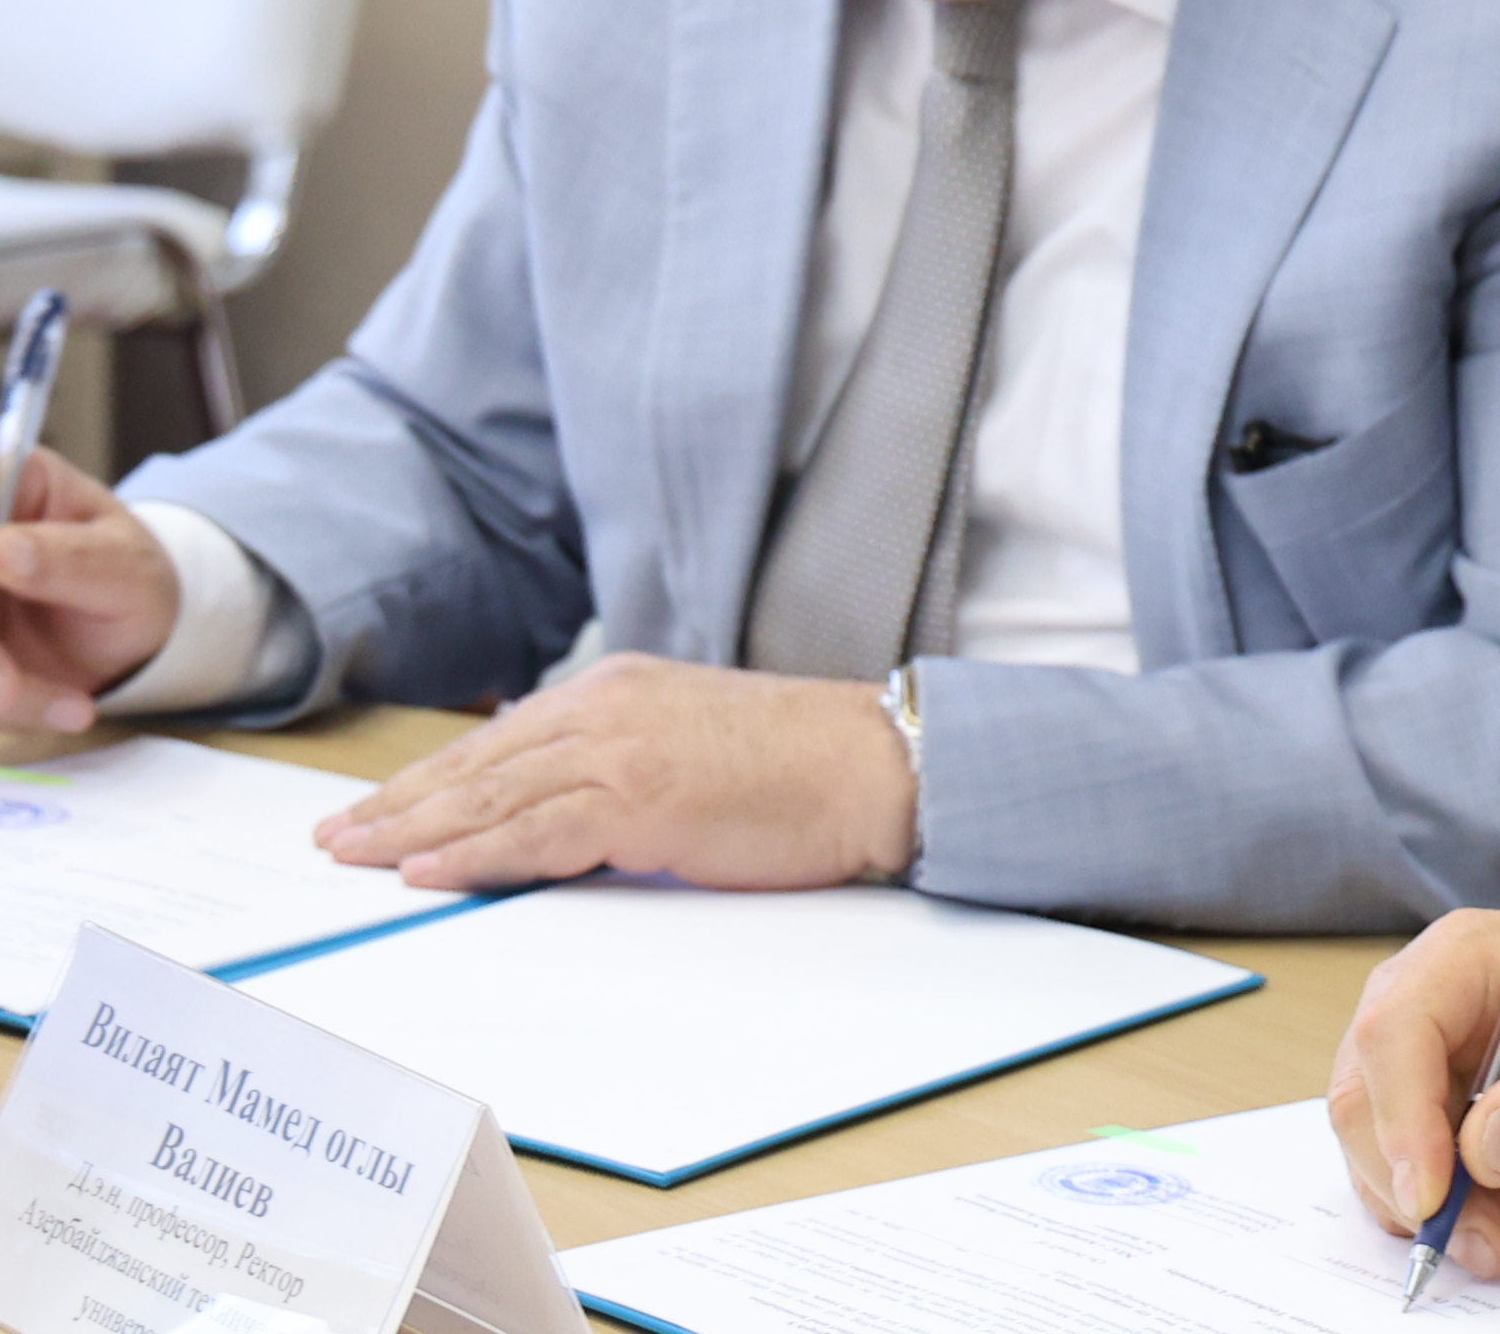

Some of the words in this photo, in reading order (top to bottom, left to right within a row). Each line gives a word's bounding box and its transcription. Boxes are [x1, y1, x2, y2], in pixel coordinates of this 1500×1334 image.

[81, 1000, 206, 1094] Вилаят
[205, 1059, 322, 1157] Мамед
[325, 1128, 415, 1196] оглы
[148, 1121, 274, 1218] Валиев
[18, 1198, 190, 1303] Азербайджанский
[126, 1194, 230, 1269] профессор,
[235, 1241, 305, 1305] Ректор
